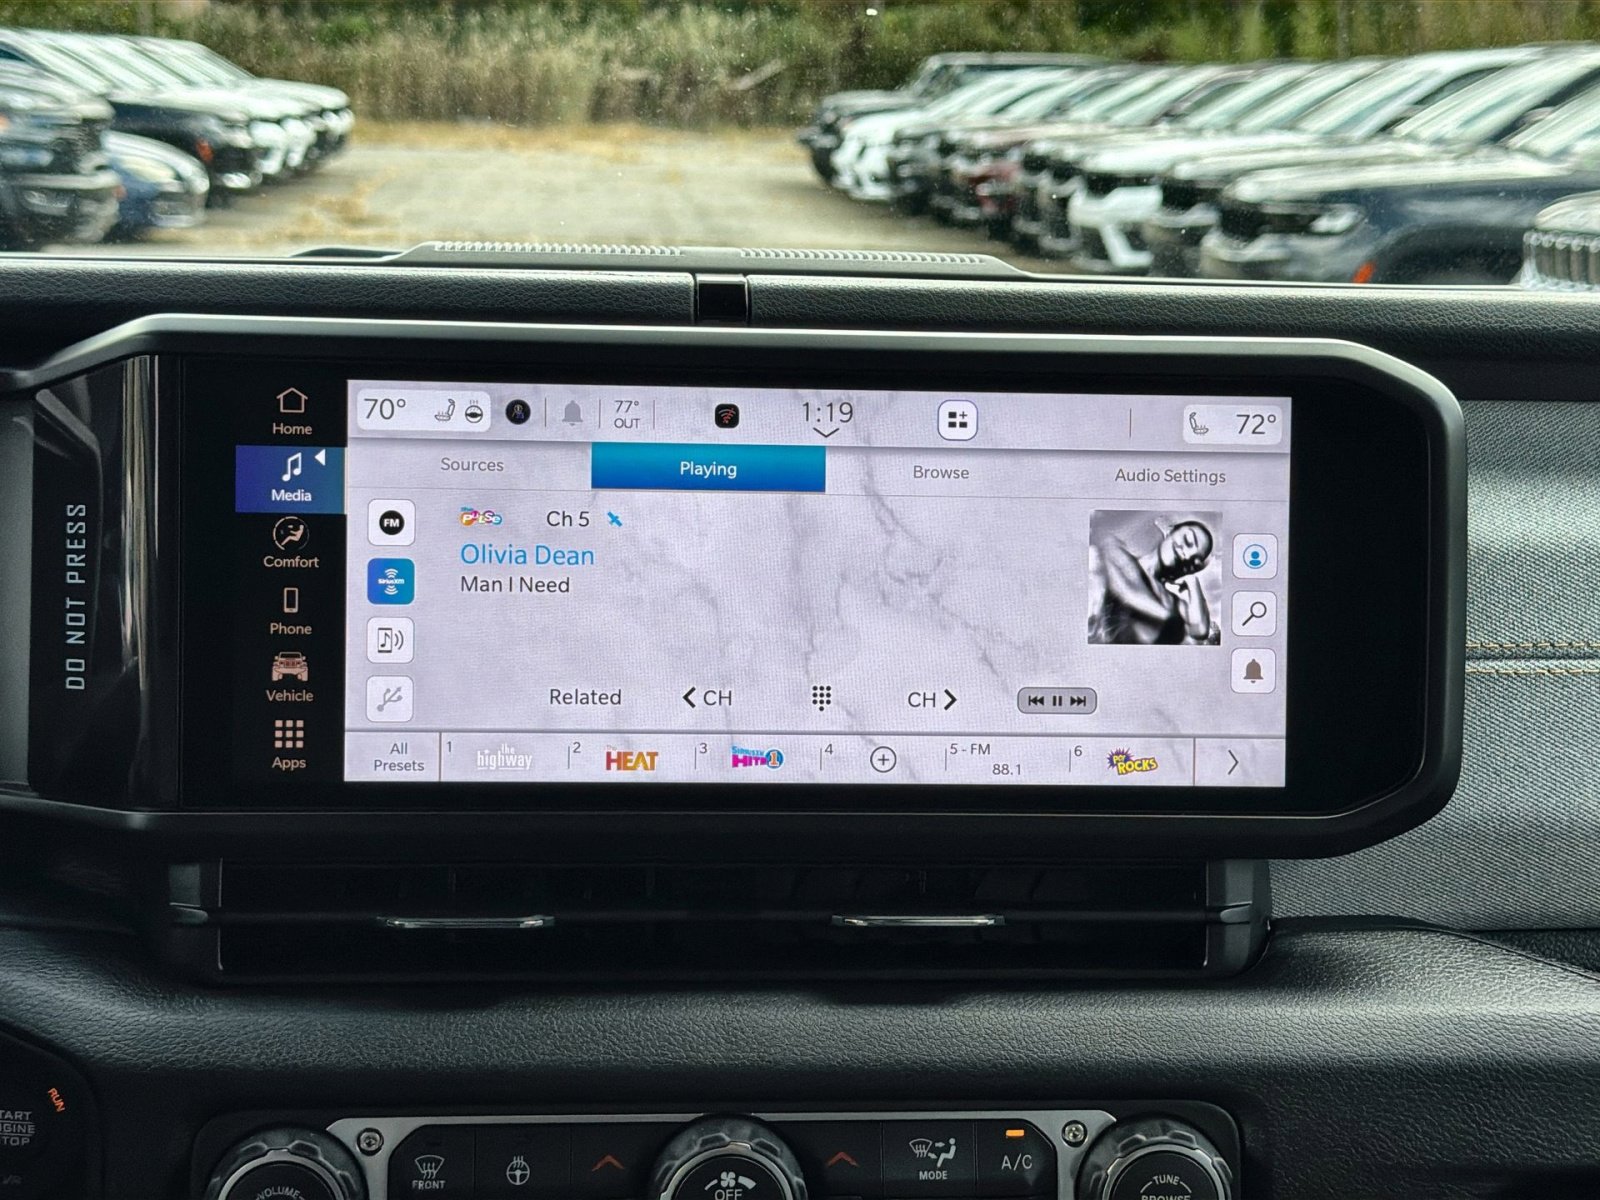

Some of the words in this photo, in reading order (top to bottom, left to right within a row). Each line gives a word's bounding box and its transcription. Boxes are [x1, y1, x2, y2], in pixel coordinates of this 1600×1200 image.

[802, 401, 854, 424] 1:19
[272, 422, 313, 436] Home
[614, 418, 640, 429] OUT
[440, 457, 504, 473] Sources
[680, 460, 738, 479] Playing
[913, 465, 970, 480] Browse
[1115, 468, 1160, 483] Audio
[1164, 469, 1226, 486] Settings
[271, 489, 312, 503] Media
[383, 519, 401, 528] FM
[546, 511, 573, 527] Ch
[578, 511, 590, 527] 5
[65, 503, 87, 585] PRESS
[263, 555, 320, 569] Comfort
[460, 543, 528, 565] Olivia
[535, 545, 595, 566] Dean
[460, 576, 503, 593] Man
[509, 577, 513, 593] I
[519, 577, 570, 594] Need
[64, 596, 87, 645] NOT
[270, 622, 313, 636] Phone
[64, 657, 86, 691] DO
[265, 688, 315, 703] Vehicle
[549, 688, 623, 706] Related
[703, 690, 733, 707] CH
[907, 691, 937, 708] CH
[389, 742, 409, 756] All
[446, 740, 454, 754] 1
[573, 741, 582, 754] 2
[699, 742, 709, 755] 3
[824, 743, 834, 756] 4
[949, 743, 958, 756] 5
[970, 743, 991, 756] FM
[1074, 744, 1083, 757] 6
[271, 757, 307, 773] Apps
[373, 759, 425, 774] Presets
[477, 751, 533, 770] highway
[605, 751, 659, 771] HEAT
[1117, 757, 1158, 775] ROCKS
[992, 763, 1022, 776] 88.1
[47, 1087, 66, 1113] RUN
[0, 1109, 33, 1121] TART
[0, 1123, 36, 1134] GINE
[0, 1135, 31, 1146] TOP
[1001, 1153, 1034, 1171] A/C
[918, 1170, 949, 1181] MODE
[1152, 1173, 1181, 1186] TUNE
[411, 1178, 447, 1191] FRONT
[256, 1185, 302, 1200] VOLUME
[714, 1188, 743, 1200] OFF
